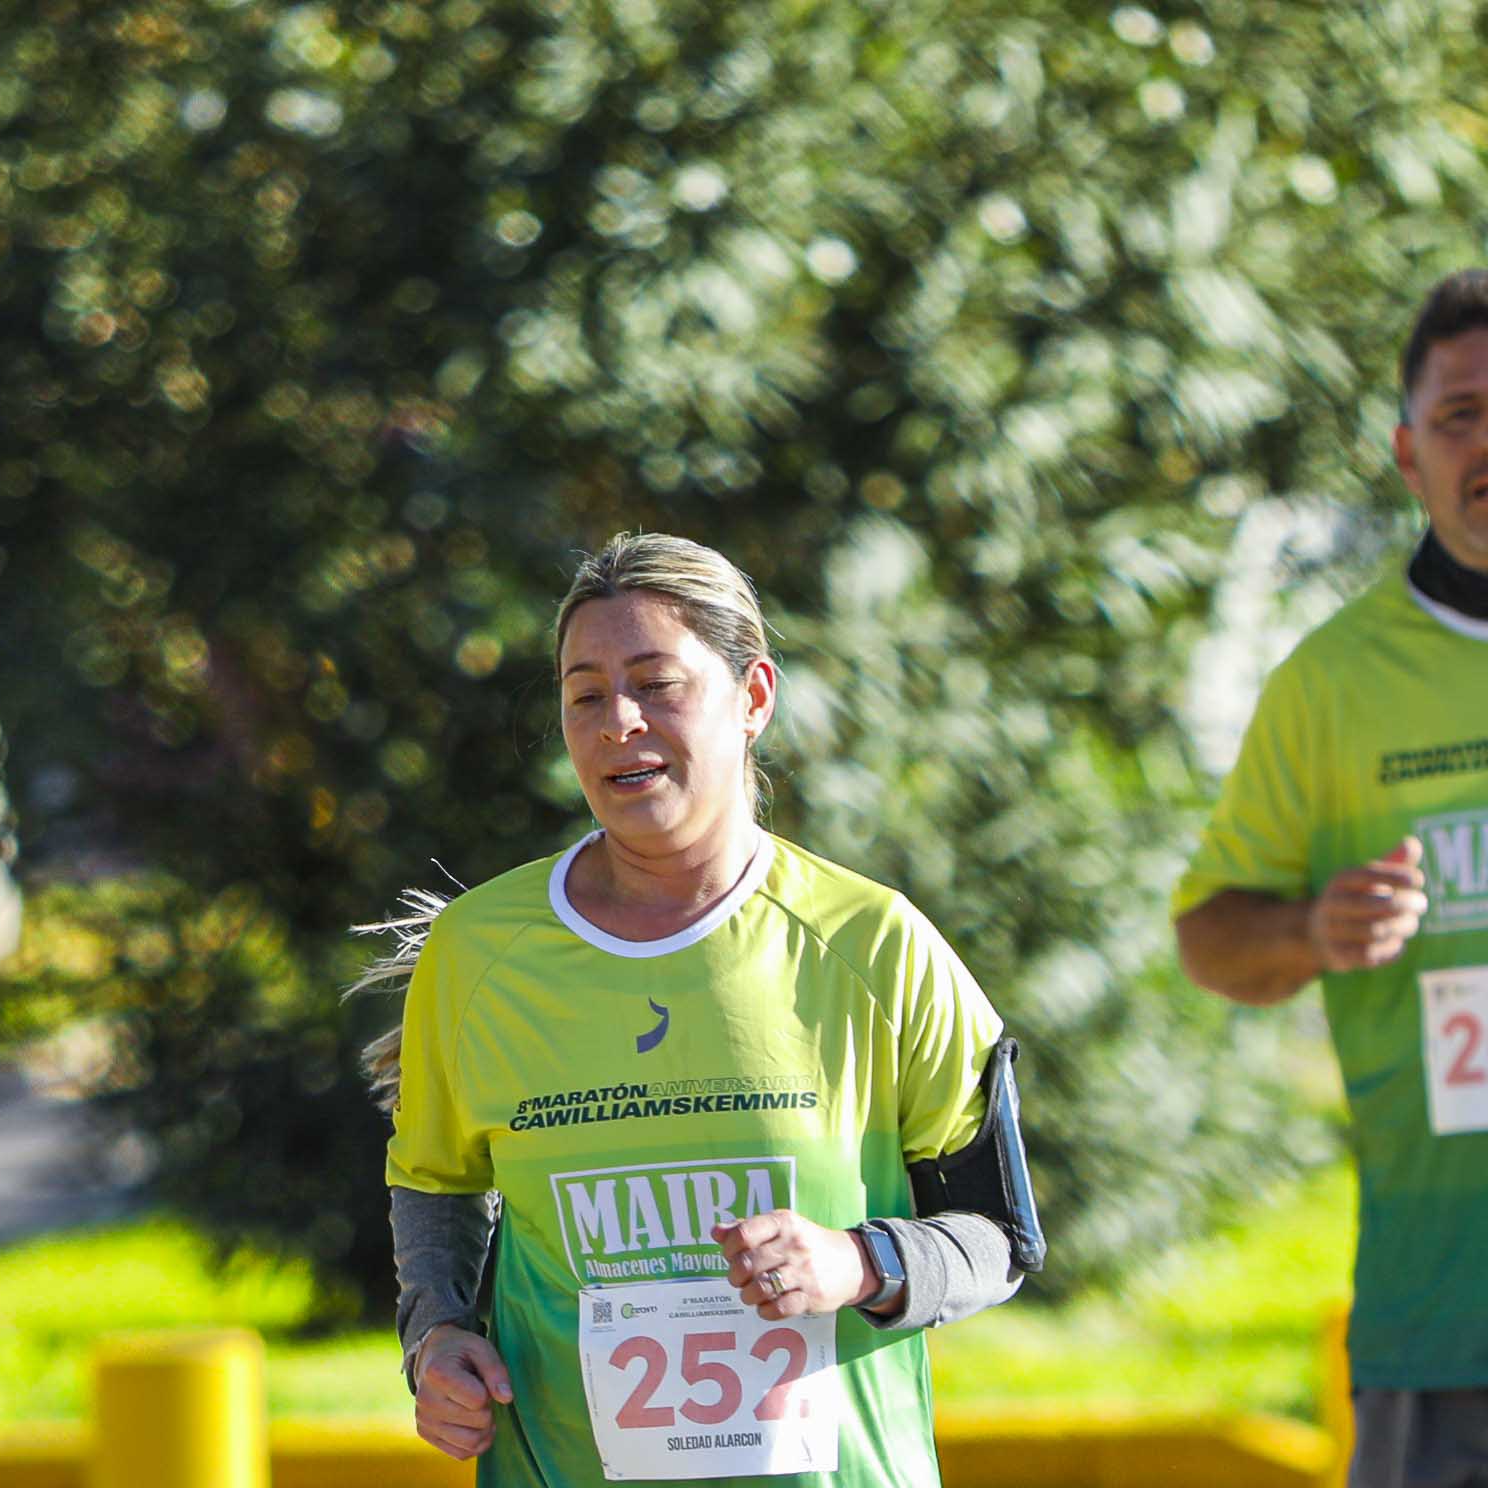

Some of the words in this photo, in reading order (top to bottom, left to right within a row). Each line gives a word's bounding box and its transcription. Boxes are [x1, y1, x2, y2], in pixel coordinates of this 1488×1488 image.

[510, 1091, 817, 1131] CAWILLIAMSKEMMIS
[566, 1169, 775, 1255] MAIRA
[585, 1256, 666, 1279] Almacenes
[608, 1327, 810, 1429] 252
[667, 1434, 712, 1451] SOLEDAD
[714, 1432, 762, 1449] ALARCON
